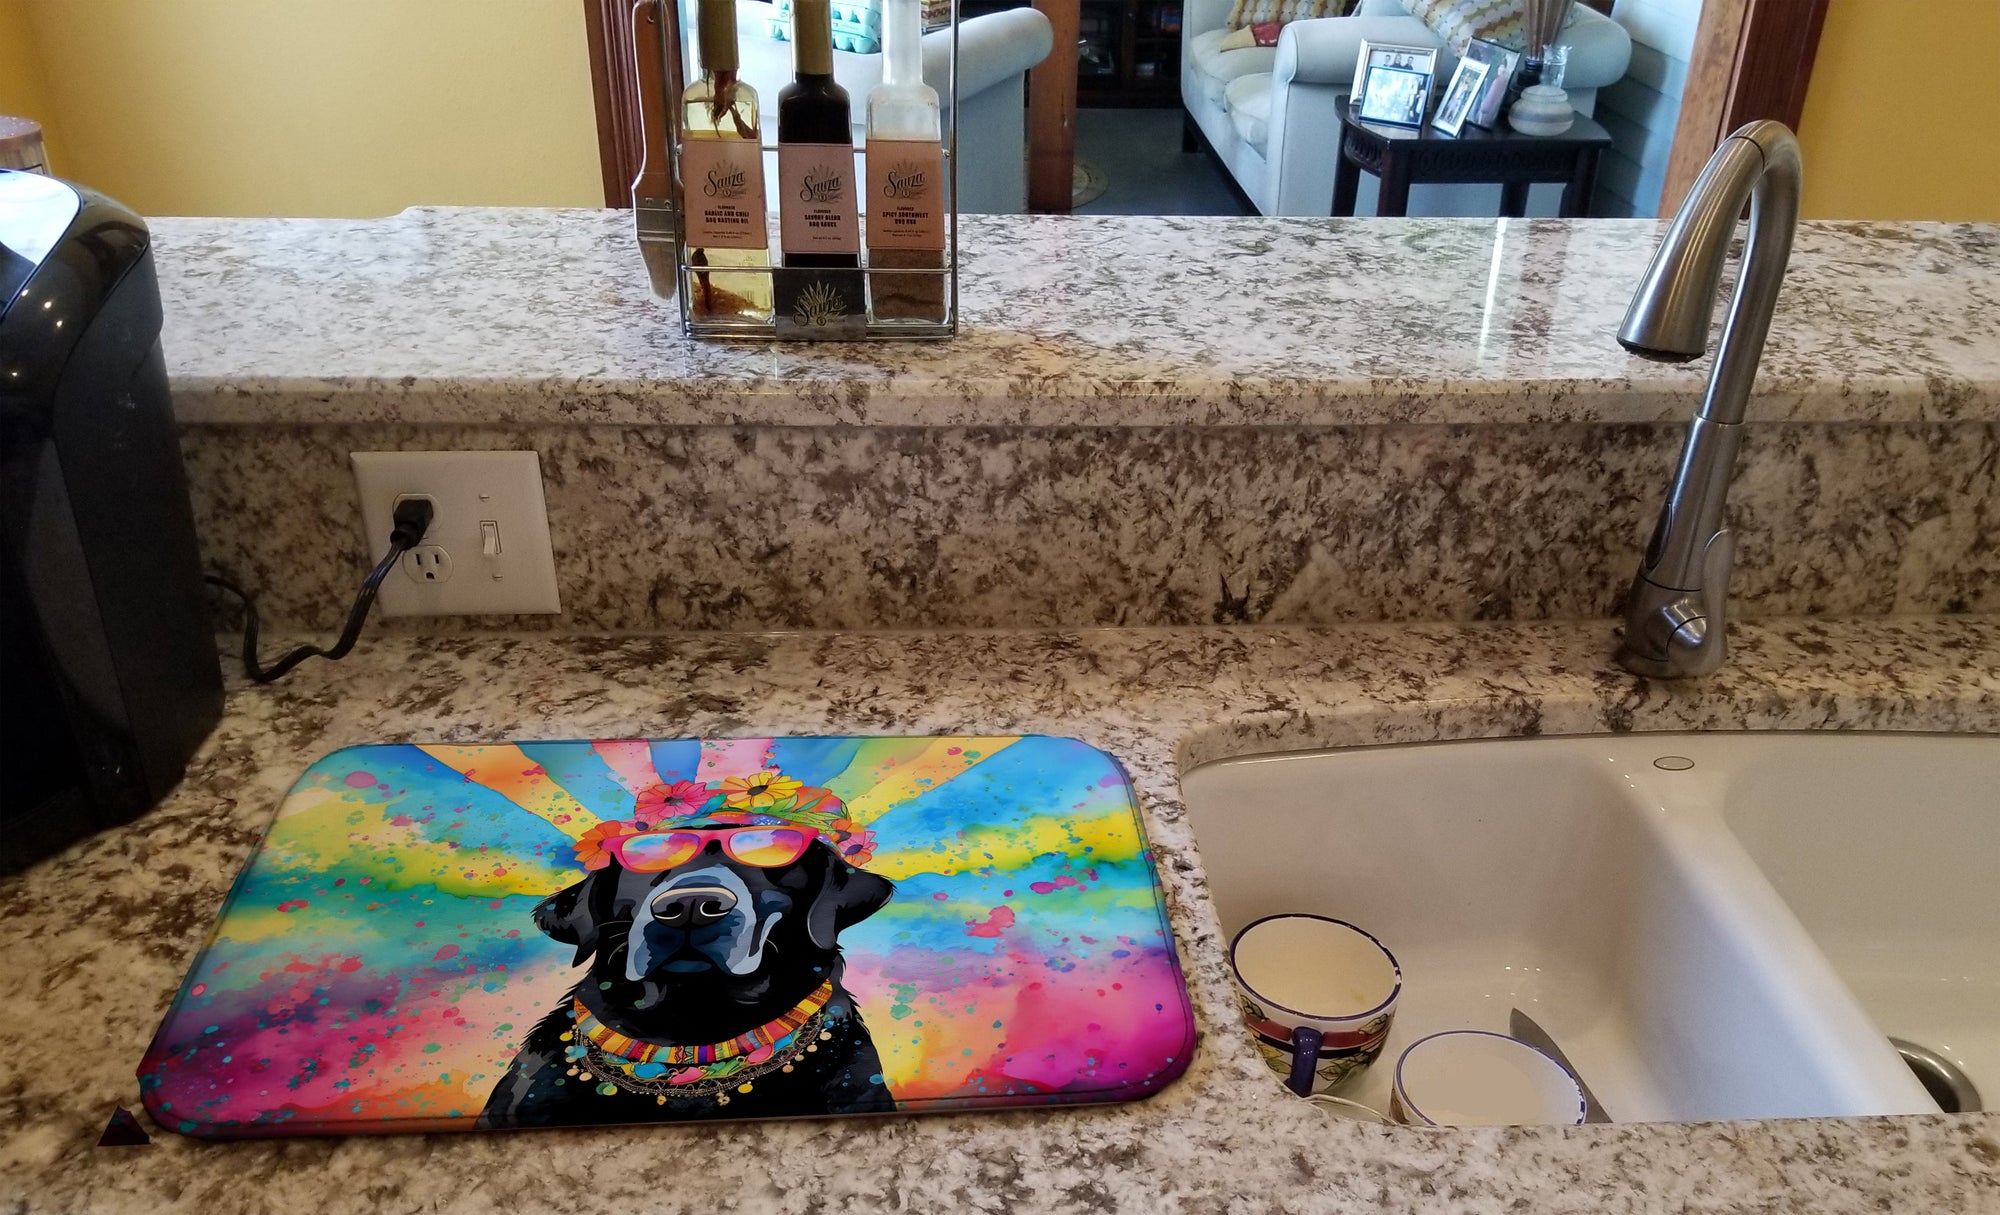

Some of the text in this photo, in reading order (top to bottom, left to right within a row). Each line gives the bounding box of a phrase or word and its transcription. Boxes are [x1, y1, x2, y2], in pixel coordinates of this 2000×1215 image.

[704, 171, 745, 197] Sauza
[800, 175, 841, 202] Sauza
[884, 171, 924, 198] Sauza
[793, 296, 844, 326] Sauza
